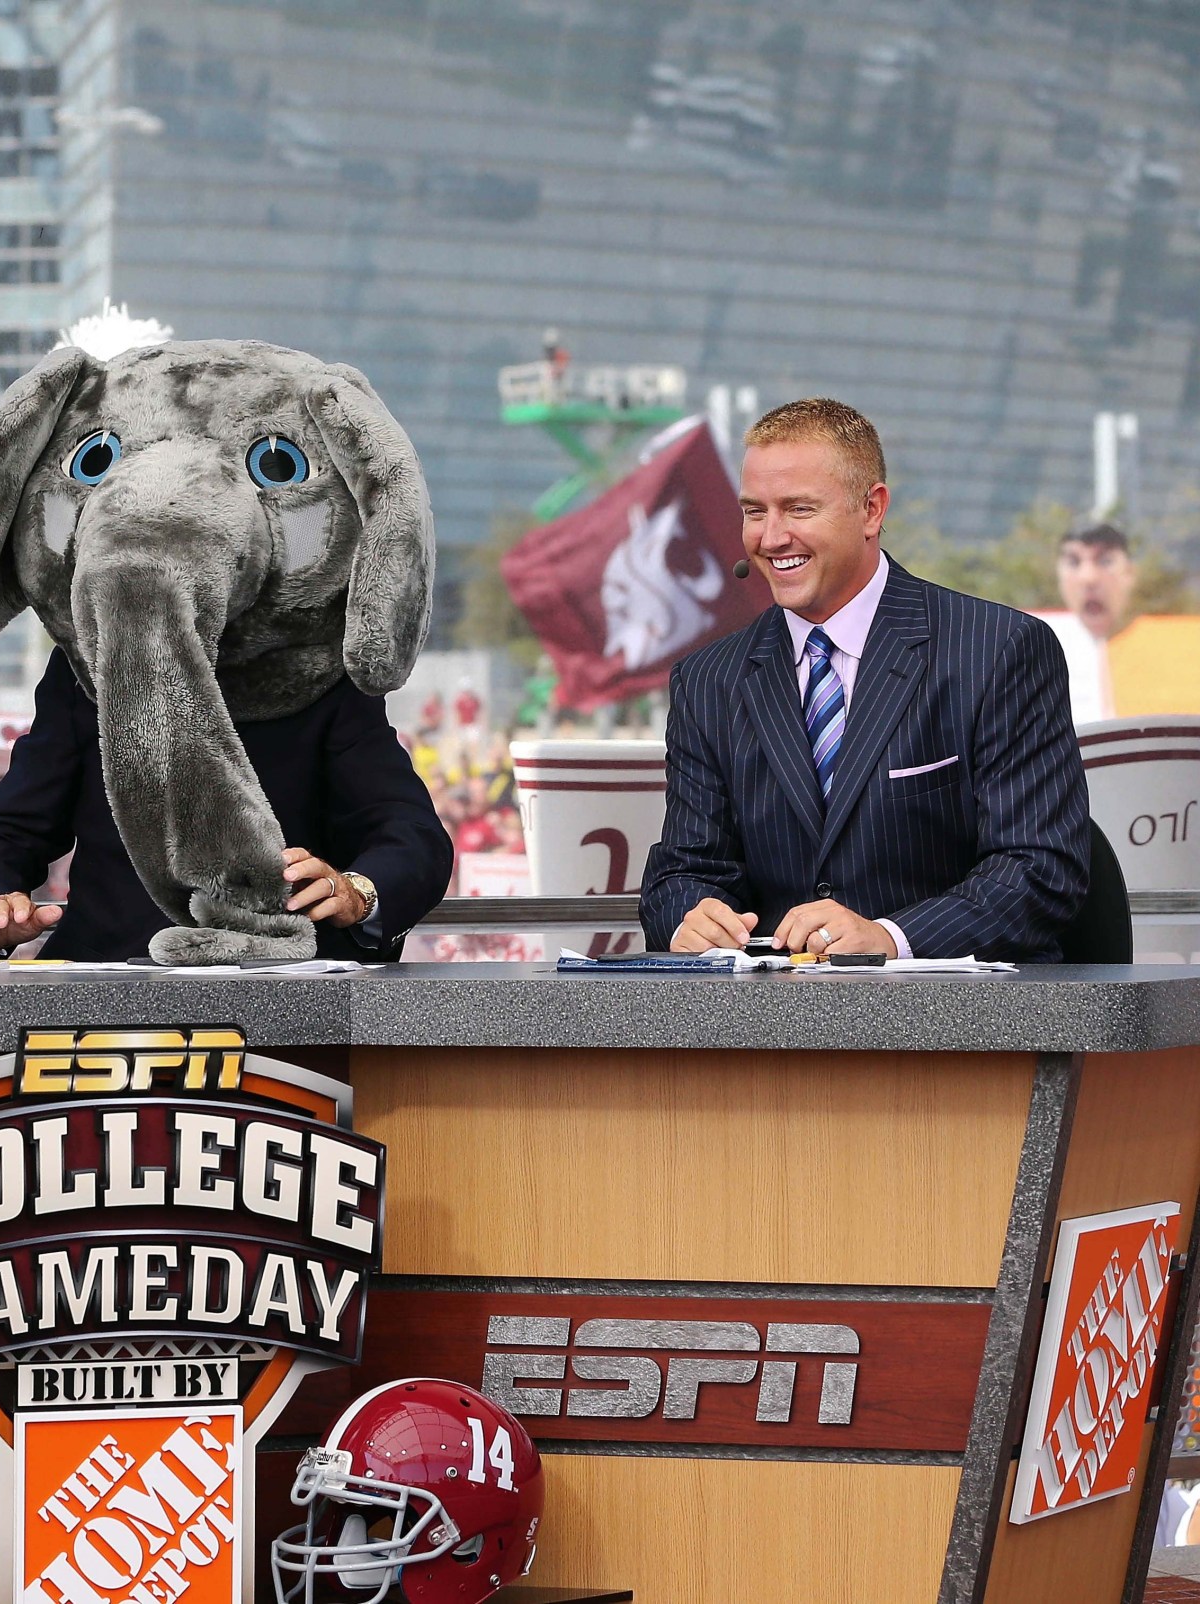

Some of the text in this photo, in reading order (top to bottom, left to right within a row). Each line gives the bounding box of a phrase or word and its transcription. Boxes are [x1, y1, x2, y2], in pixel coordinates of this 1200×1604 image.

[19, 1030, 246, 1093] ESPN
[1067, 1248, 1123, 1369] THE
[30, 1361, 230, 1402] BUILT BY
[481, 1315, 861, 1425] ESPN
[1036, 1215, 1175, 1509] HOME
[1074, 1312, 1159, 1499] DEPOT
[37, 1433, 136, 1534] THE
[467, 1417, 515, 1492] 14
